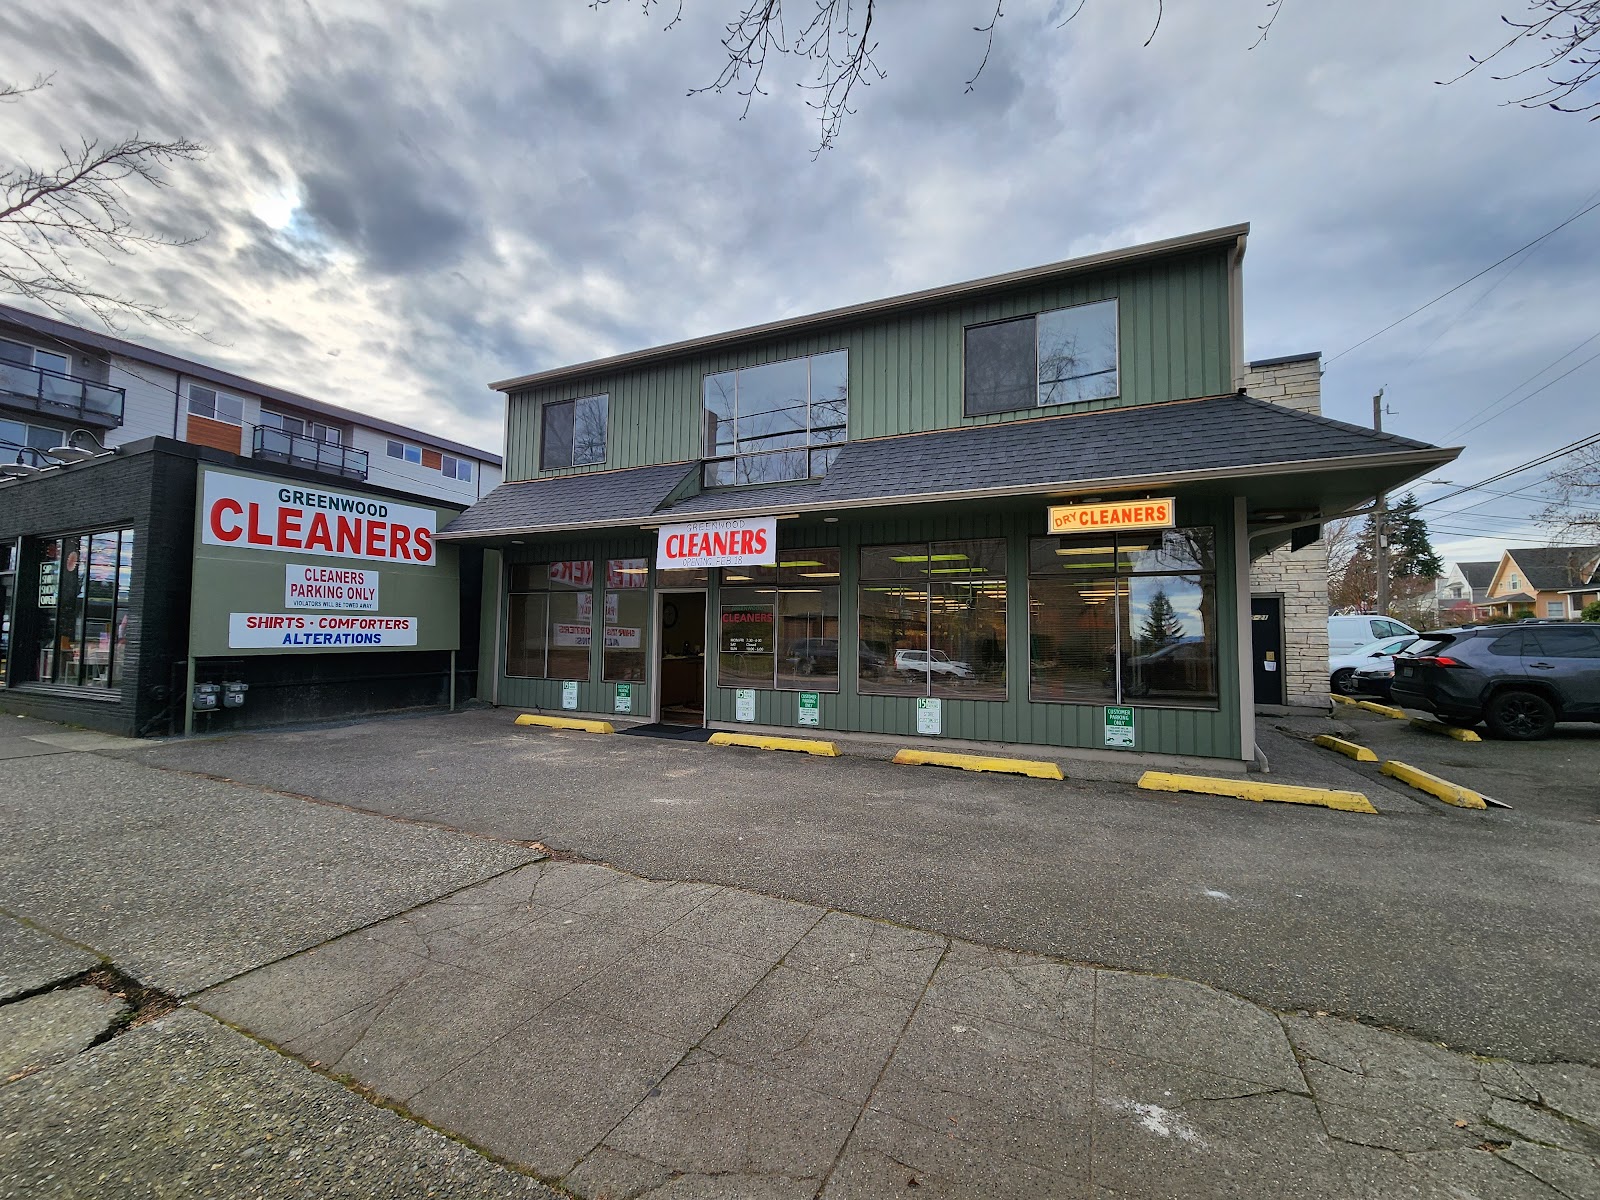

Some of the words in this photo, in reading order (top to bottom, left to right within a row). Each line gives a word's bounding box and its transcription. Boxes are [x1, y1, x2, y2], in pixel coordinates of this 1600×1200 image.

[278, 488, 388, 518] GREENWOOD
[1055, 512, 1077, 527] DRY
[1079, 505, 1167, 526] CLEANERS
[210, 497, 433, 561] CLEANERS
[686, 520, 746, 532] GREENWOOD
[665, 528, 768, 559] CLEANERS
[304, 567, 364, 585] CLEANERS
[290, 583, 343, 599] PARKING
[347, 586, 375, 600] ONLY
[246, 616, 305, 629] SHIRTS
[318, 617, 410, 630] COMFORTERS
[722, 613, 773, 623] CLEANERS
[282, 632, 382, 645] ALTERATIONS
[918, 698, 927, 708] 15
[1107, 708, 1131, 716] CUSTOMER
